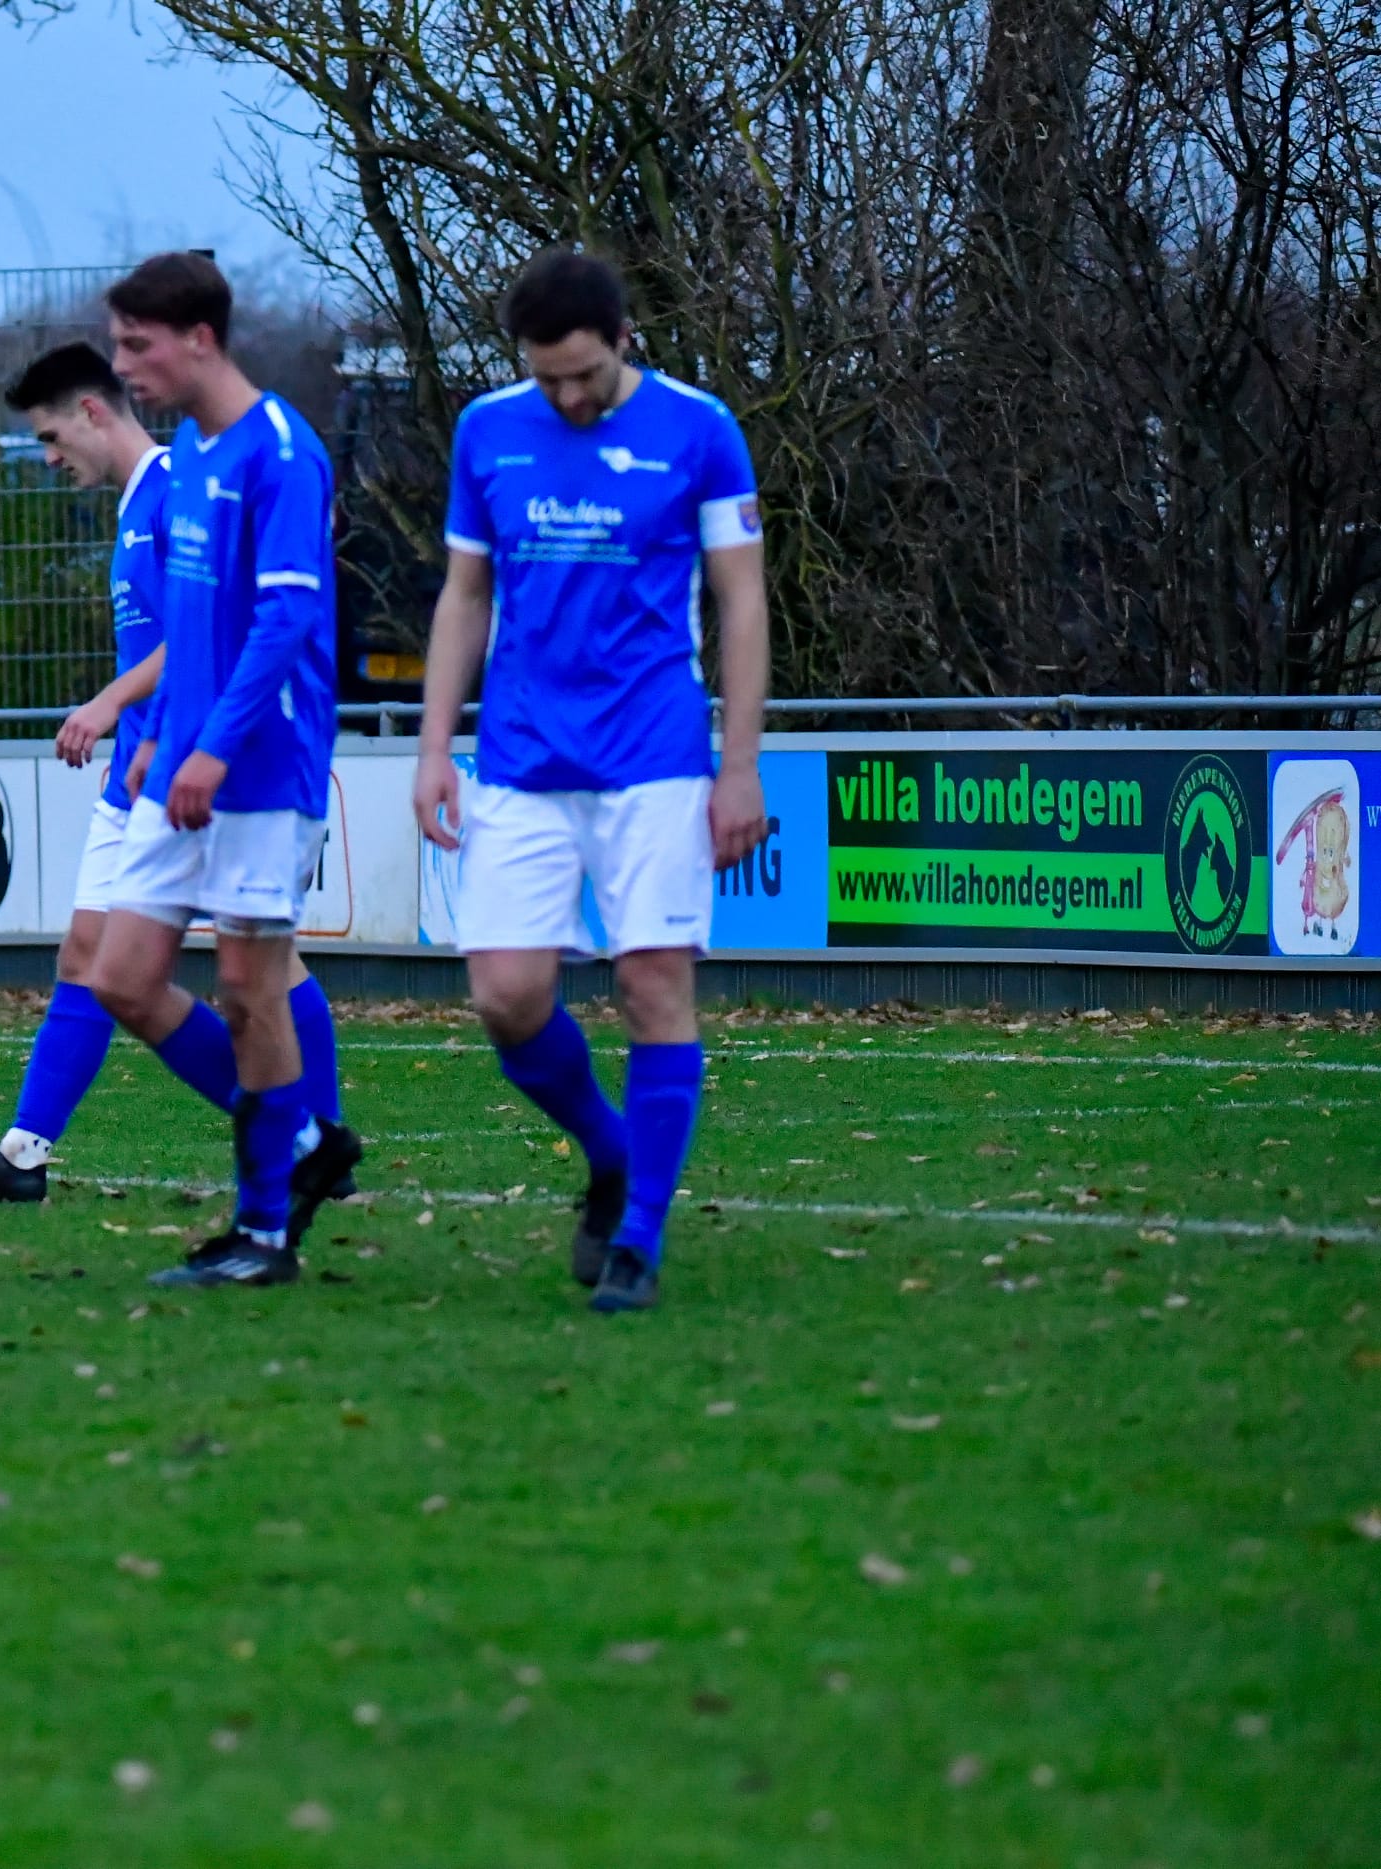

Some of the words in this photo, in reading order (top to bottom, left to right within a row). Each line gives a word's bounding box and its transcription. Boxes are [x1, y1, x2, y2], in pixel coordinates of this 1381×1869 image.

[836, 760, 920, 823] villa
[934, 762, 1143, 843] hondegem
[836, 861, 1143, 919] www.villahondegem.nl
